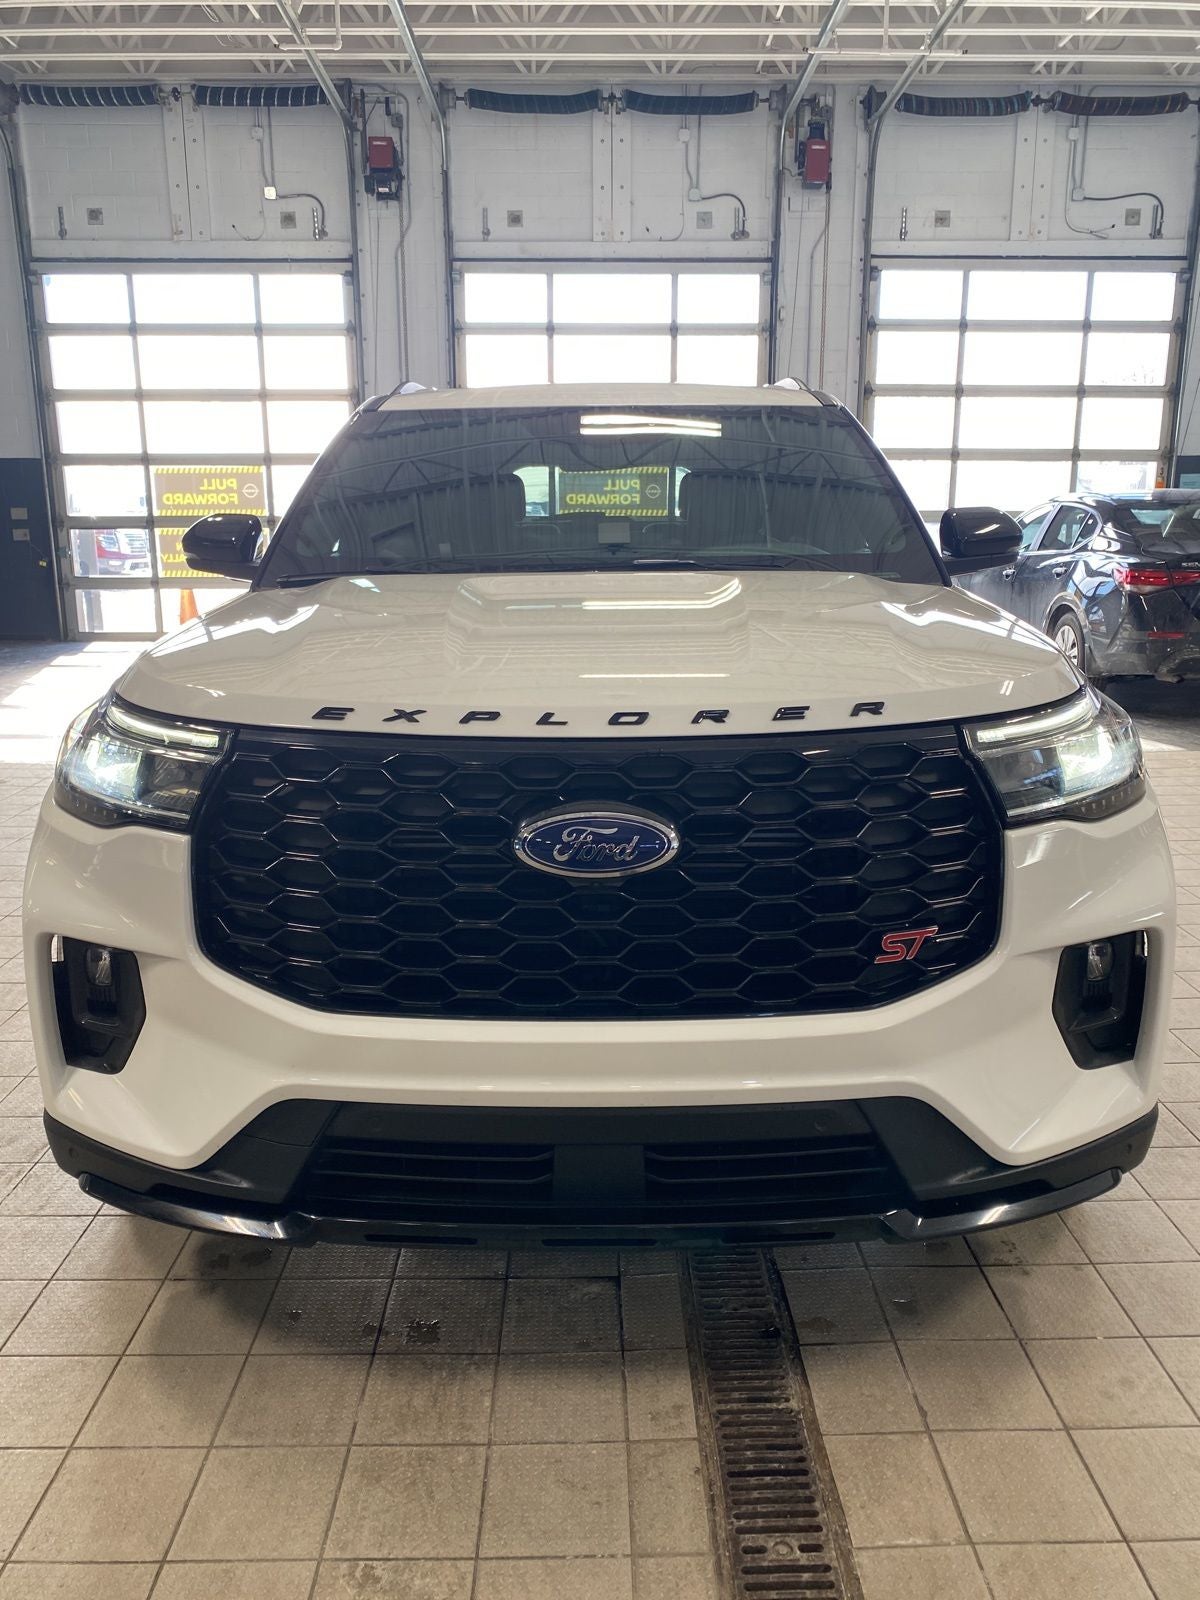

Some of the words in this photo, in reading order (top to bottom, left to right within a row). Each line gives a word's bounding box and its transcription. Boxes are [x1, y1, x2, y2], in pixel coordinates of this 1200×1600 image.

[312, 701, 885, 726] EXPLORER
[553, 826, 638, 862] Ford
[874, 925, 939, 964] ST
